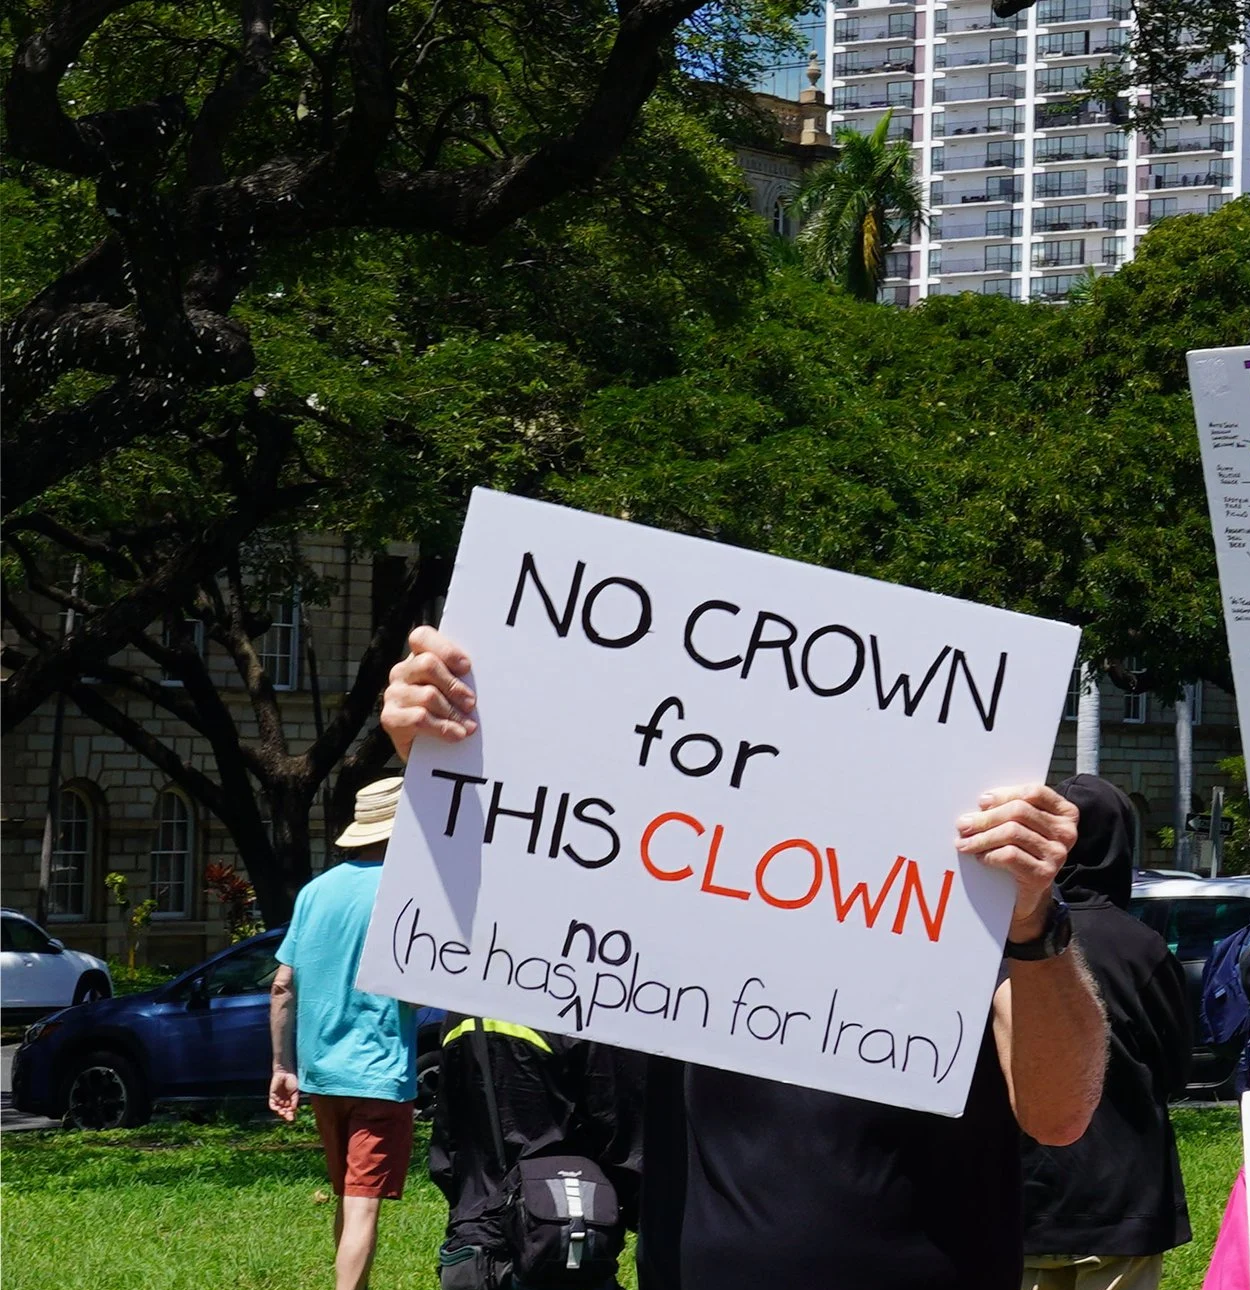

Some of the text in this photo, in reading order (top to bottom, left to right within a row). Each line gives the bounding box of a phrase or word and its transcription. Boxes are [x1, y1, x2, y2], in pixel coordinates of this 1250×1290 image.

[505, 551, 1008, 732] NO CROWN
[634, 695, 780, 789] for
[431, 768, 955, 942] THIS CLOWN
[392, 896, 965, 1085] (he has plan for Iran)
[560, 918, 633, 967] no
